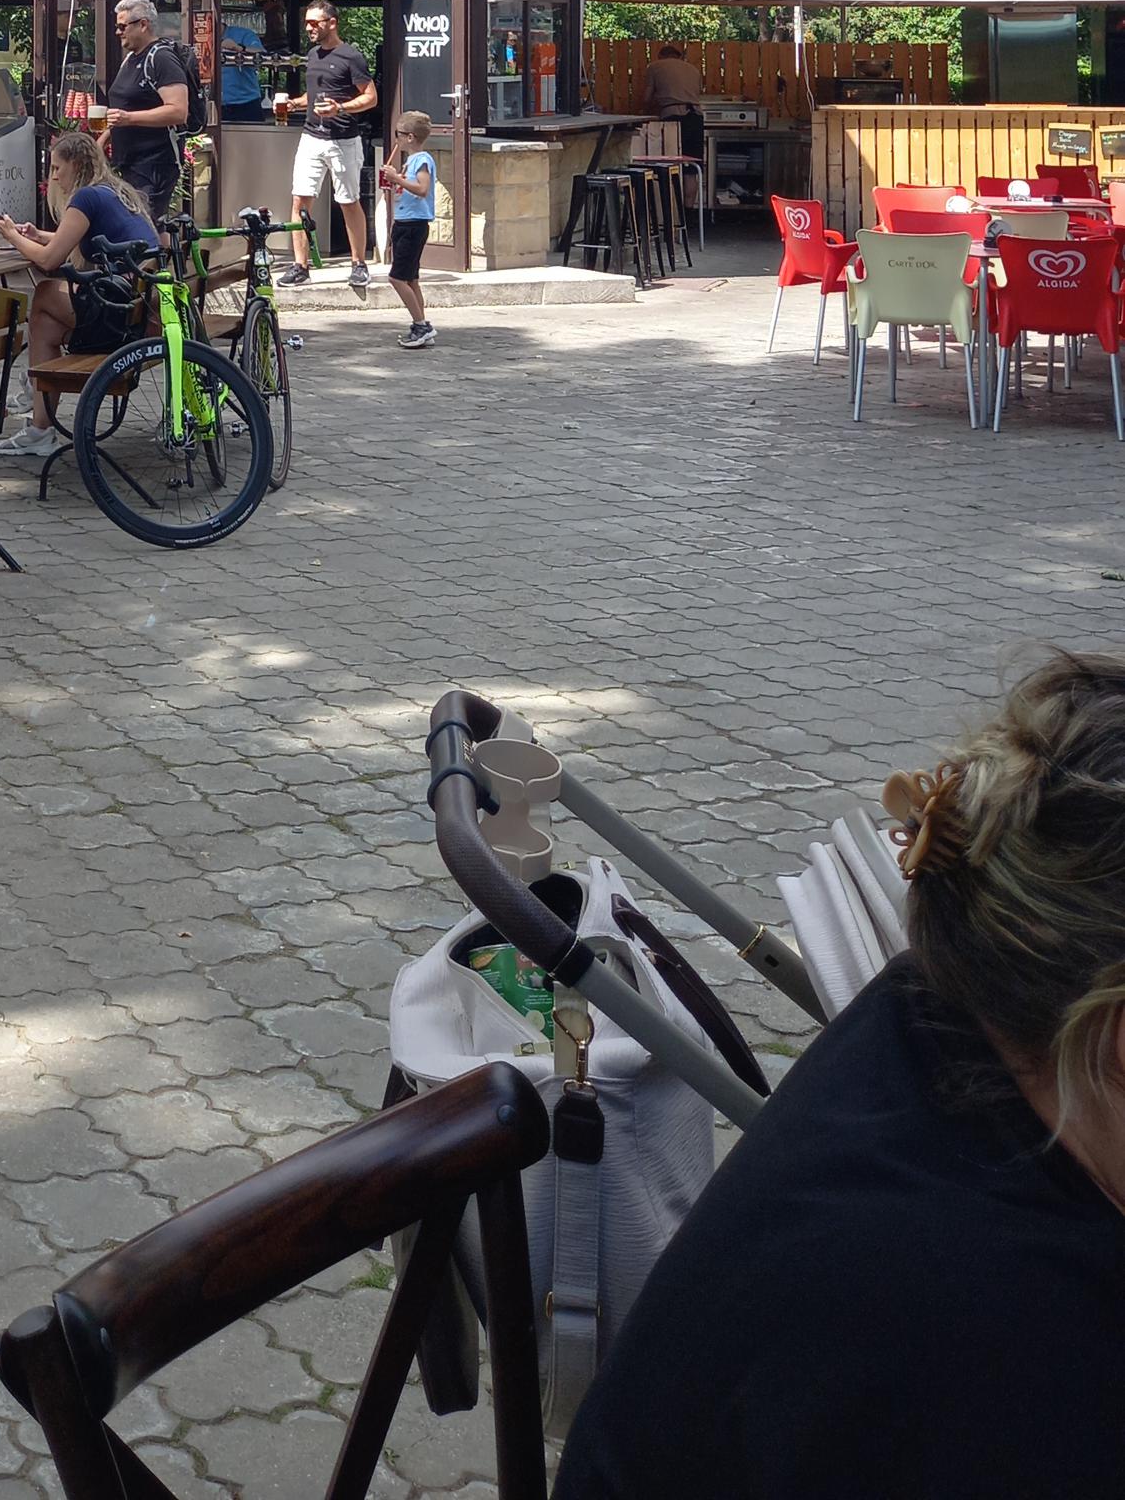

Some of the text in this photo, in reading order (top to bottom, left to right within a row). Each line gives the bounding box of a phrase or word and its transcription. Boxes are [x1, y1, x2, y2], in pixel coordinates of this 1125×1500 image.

[407, 41, 441, 57] EXIT
[888, 259, 912, 269] CARTE
[1037, 279, 1078, 288] ALGIDA
[113, 344, 163, 373] DT SWISS
